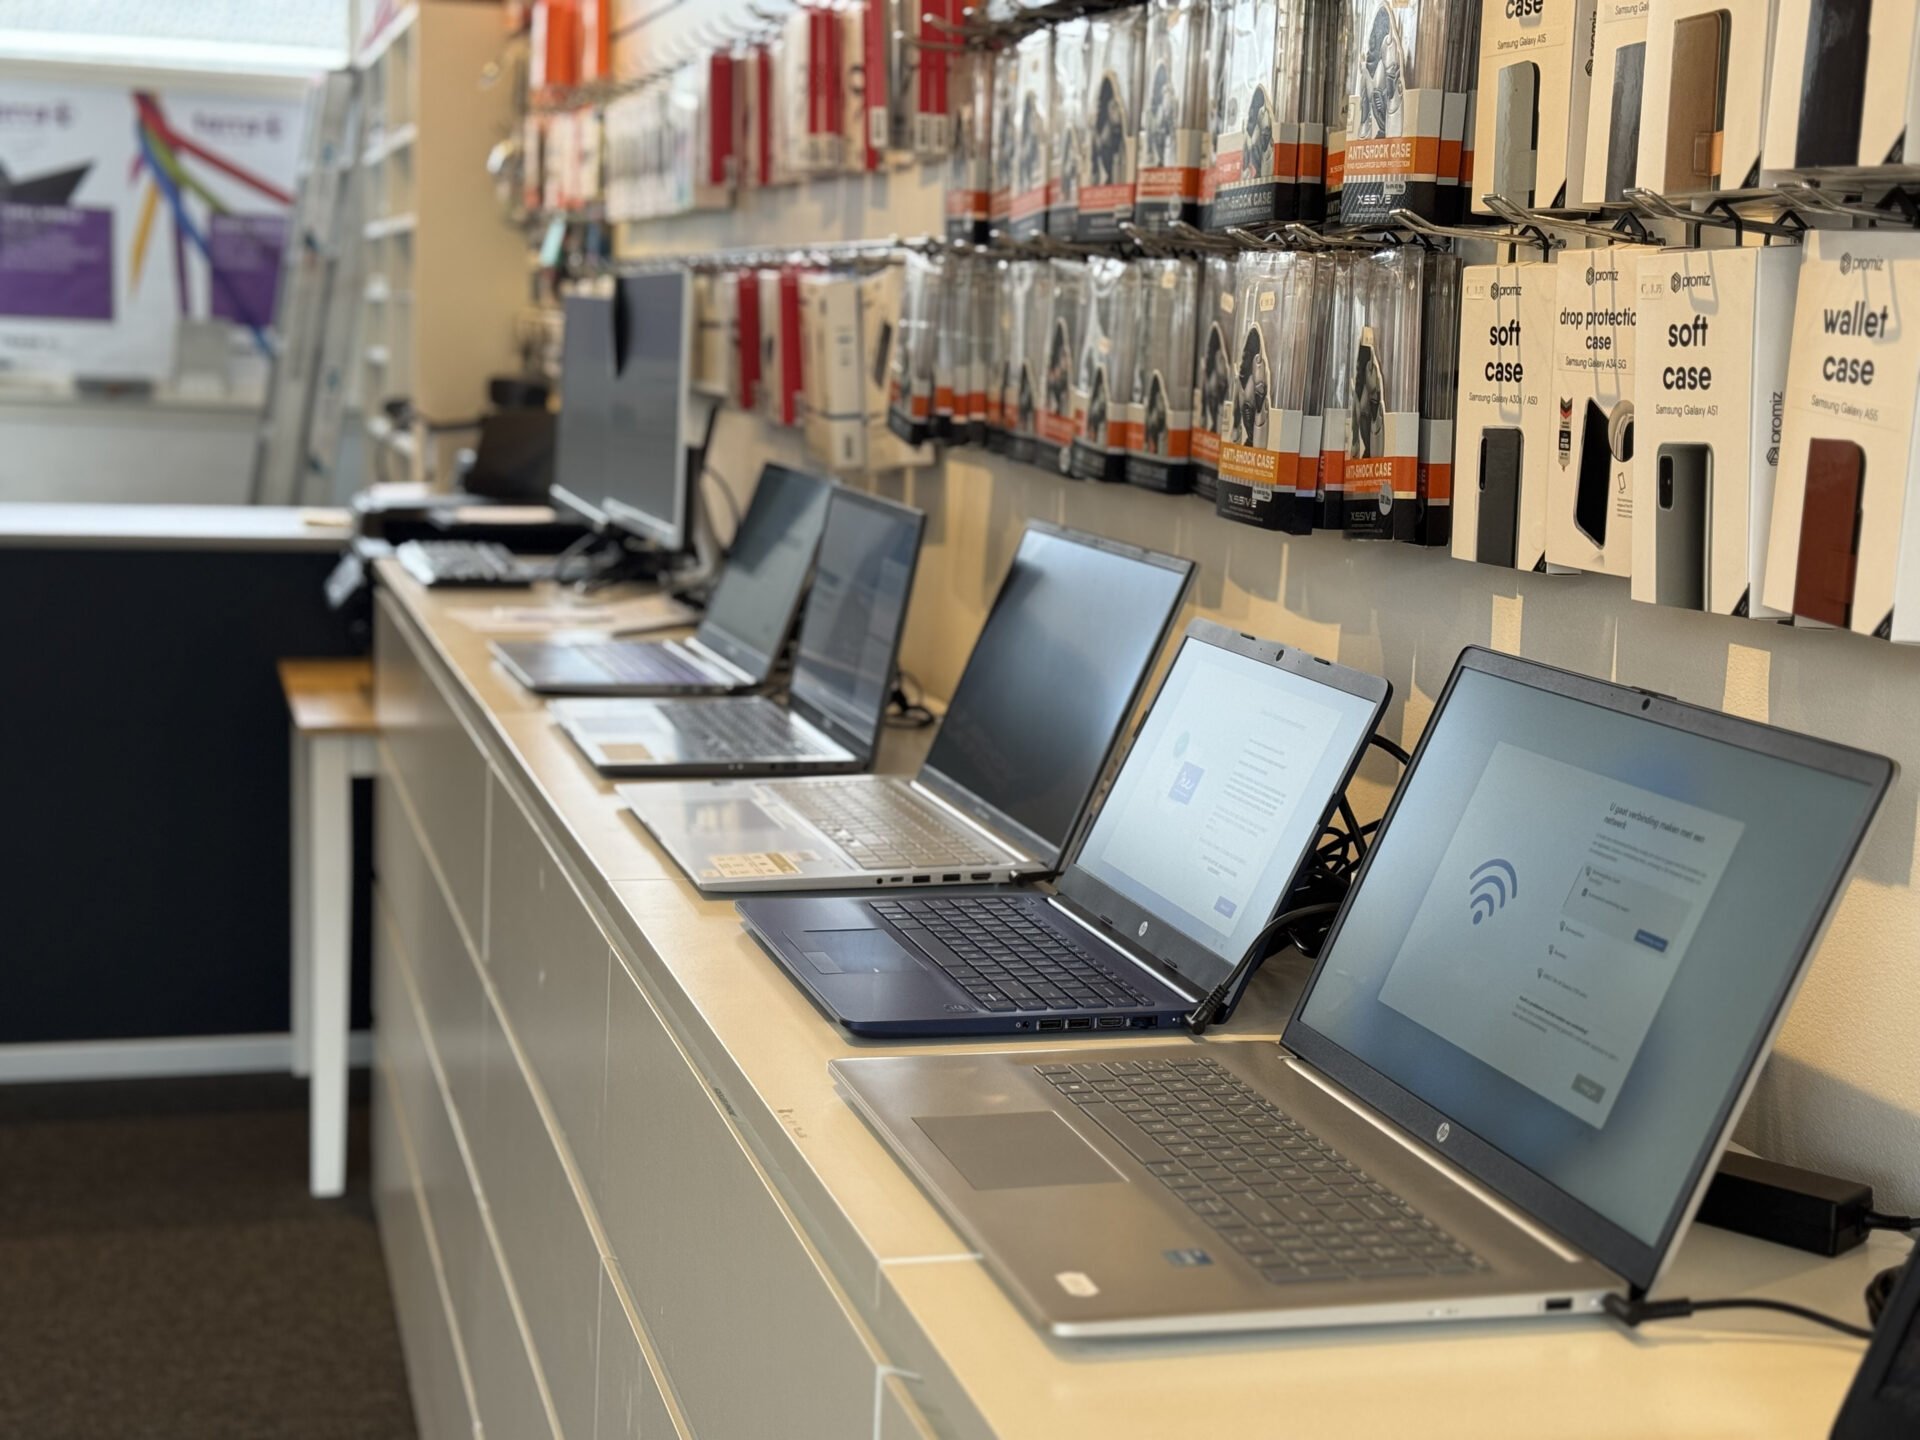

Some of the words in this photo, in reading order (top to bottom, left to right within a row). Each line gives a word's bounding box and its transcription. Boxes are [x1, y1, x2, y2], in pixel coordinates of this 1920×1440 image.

[1615, 4, 1638, 15] Samsung
[1497, 39, 1518, 50] Samsung
[1519, 36, 1536, 47] Galaxy
[1536, 33, 1547, 44] A15
[1348, 143, 1389, 160] ANTI-SHOCK
[1390, 142, 1412, 158] CASE
[1253, 191, 1272, 207] CASE
[1852, 256, 1884, 274] promiz
[1595, 267, 1619, 284] promiz
[1682, 271, 1711, 291] promiz
[1499, 283, 1522, 299] promiz
[1559, 307, 1584, 330] drop
[1823, 300, 1888, 339] wallet
[1489, 318, 1521, 346] soft
[1668, 314, 1708, 347] soft
[1585, 335, 1612, 350] case
[1484, 361, 1524, 383] case
[1565, 355, 1587, 370] Samsung
[1587, 357, 1605, 371] Galaxy
[1822, 355, 1875, 386] case
[1662, 365, 1712, 391] case
[1468, 392, 1491, 405] Samsung
[1491, 393, 1508, 405] Galaxy
[1811, 394, 1840, 415] Samsung
[1840, 400, 1863, 420] Galaxy
[1656, 404, 1683, 418] Samsung
[1684, 404, 1706, 418] Galaxy
[1706, 405, 1719, 416] A51
[1769, 391, 1783, 444] promiz
[1222, 447, 1257, 468] ANTI-SHOCK
[1257, 454, 1275, 470] CASE
[1374, 462, 1392, 477] CASE
